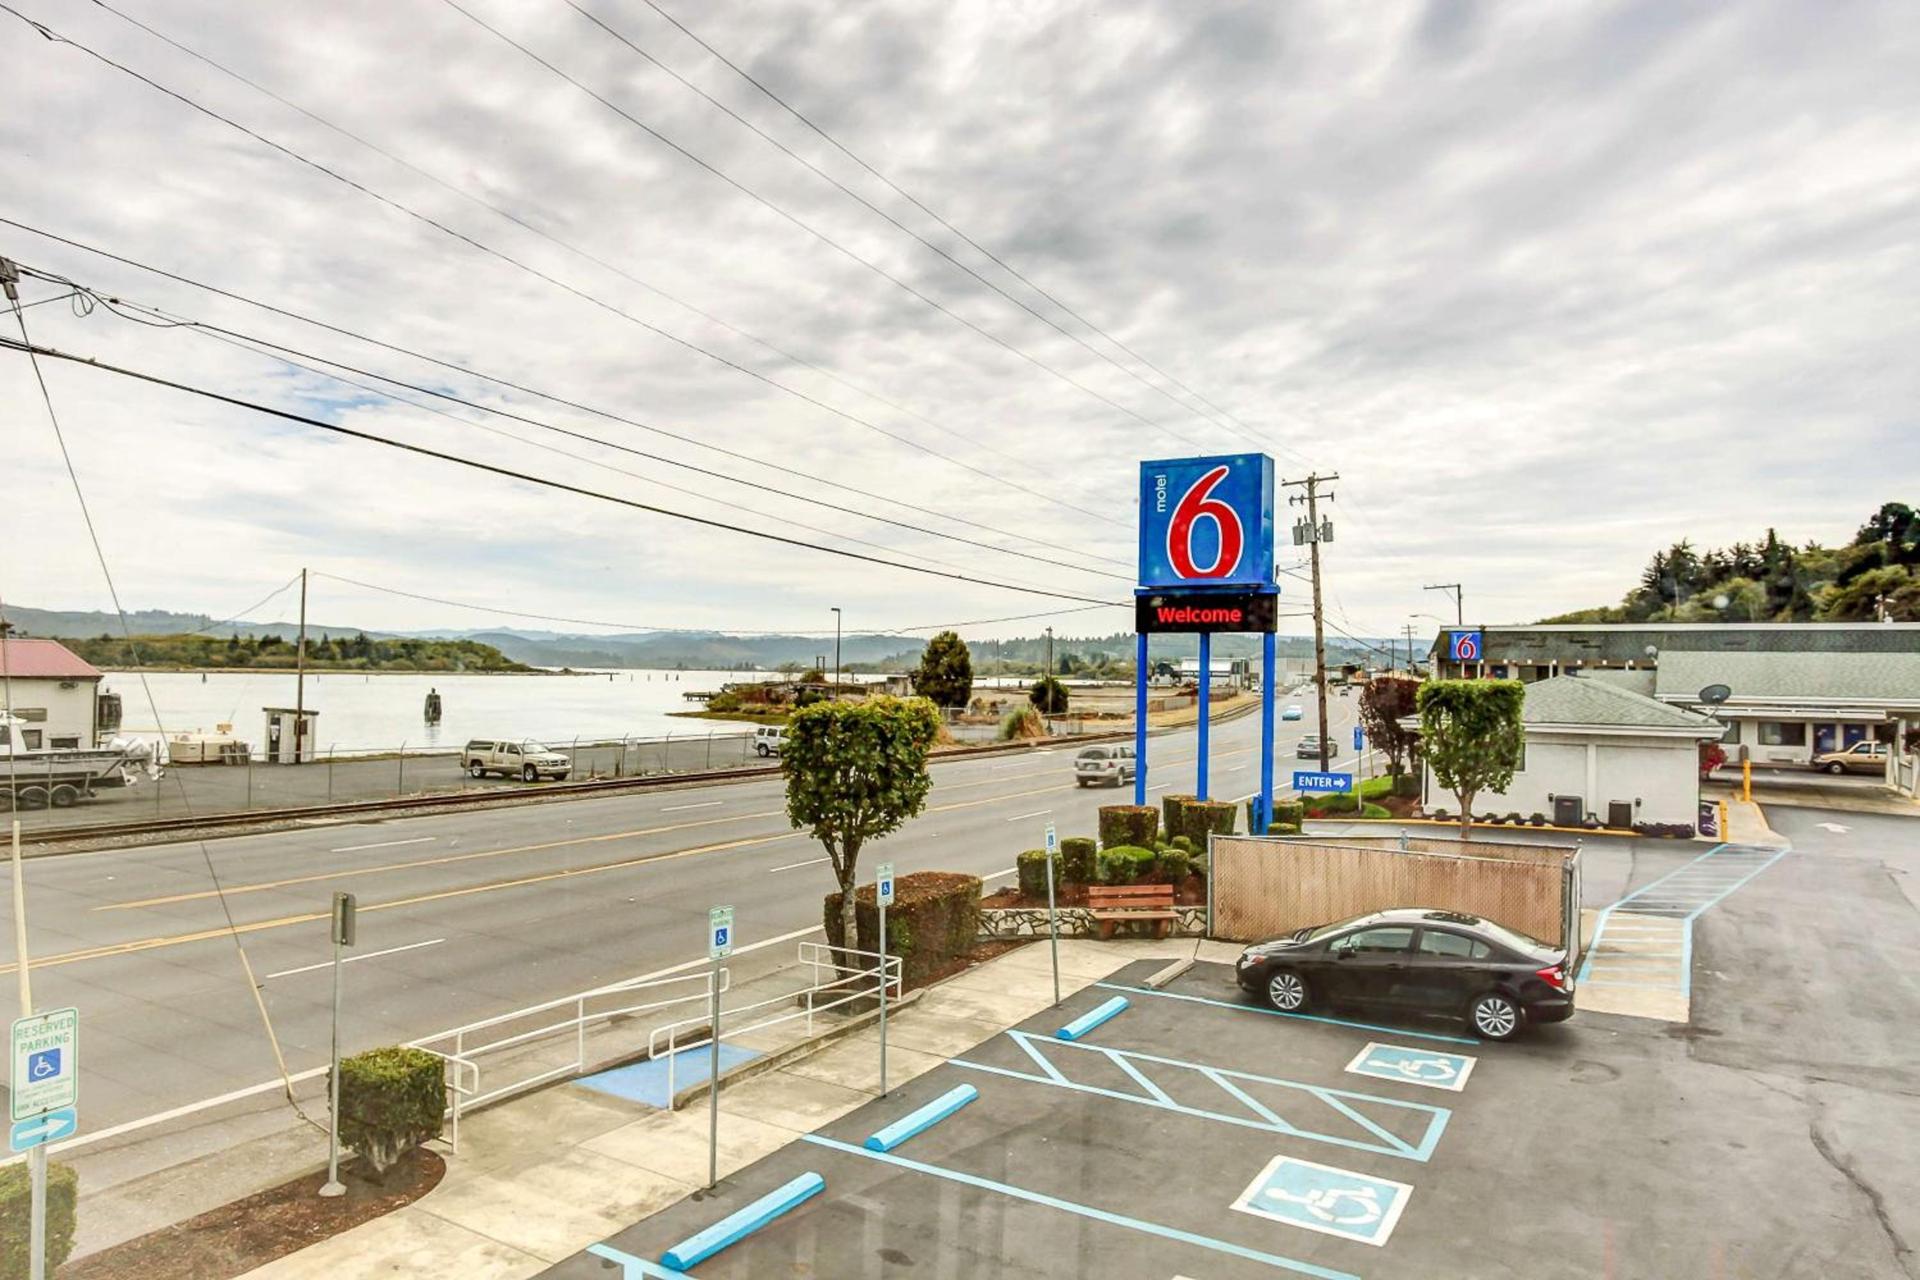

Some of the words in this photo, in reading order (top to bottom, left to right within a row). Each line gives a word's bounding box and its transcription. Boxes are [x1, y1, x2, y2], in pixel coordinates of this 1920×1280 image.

[1155, 474, 1167, 513] motel
[1166, 465, 1244, 579] 6
[1157, 606, 1242, 623] Welcome
[1456, 633, 1477, 659] 6
[1298, 776, 1332, 788] ENTER
[16, 1016, 74, 1039] RESERVED
[20, 1032, 70, 1053] PARKING
